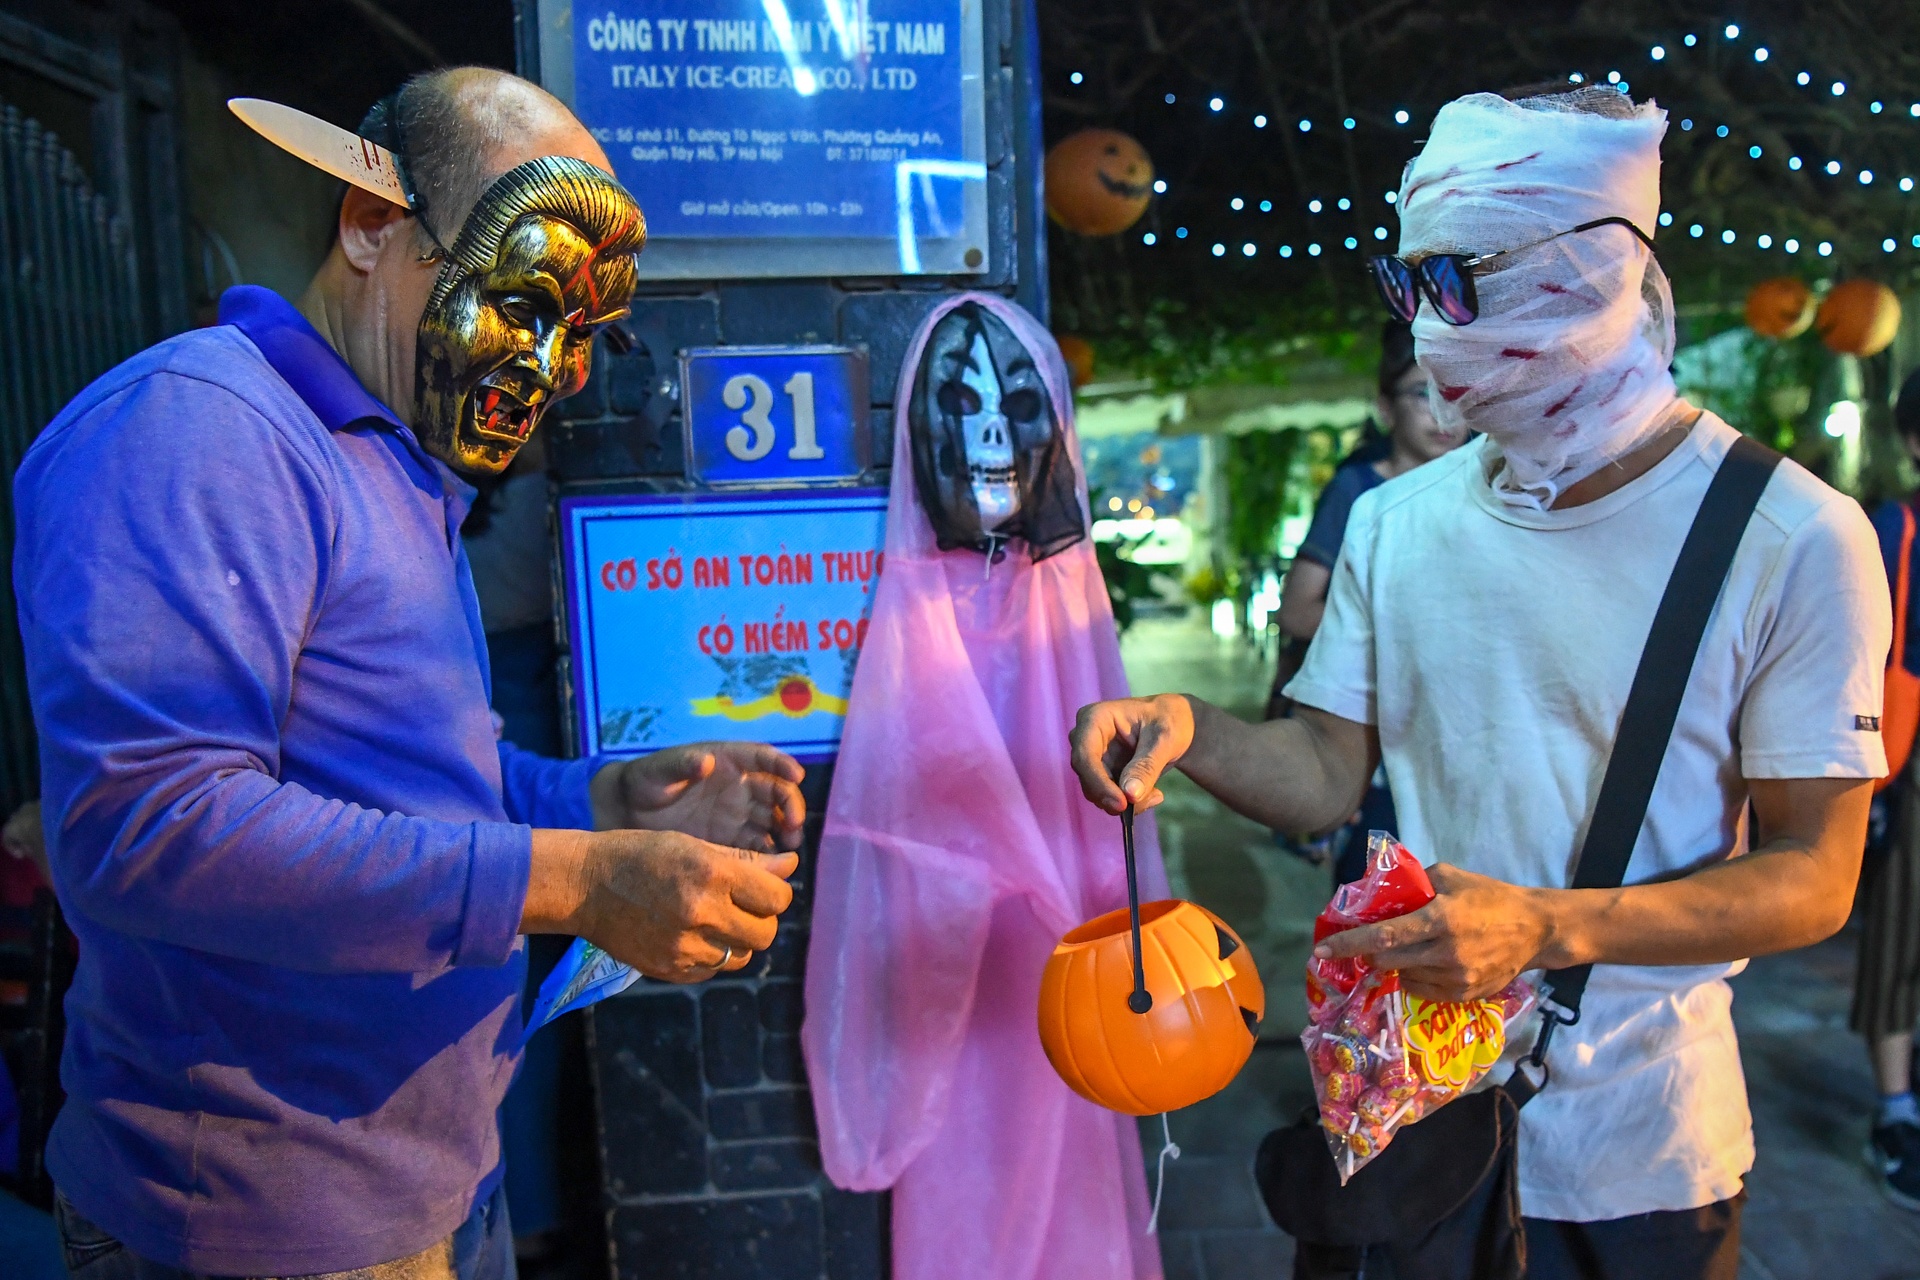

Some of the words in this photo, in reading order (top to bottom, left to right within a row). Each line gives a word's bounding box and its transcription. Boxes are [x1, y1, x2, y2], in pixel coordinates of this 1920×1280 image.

[587, 11, 653, 52] CÔNG
[657, 19, 689, 52] TY
[694, 19, 757, 52] TNHH
[762, 20, 812, 53] KM
[838, 13, 890, 63] ỆT
[895, 22, 946, 55] NAM
[611, 65, 680, 89] ITALY
[686, 65, 814, 90] ICE-CREA
[871, 68, 918, 91] LTD
[722, 371, 826, 462] 31
[600, 557, 637, 592] CƠ
[646, 547, 684, 590] SỞ
[693, 556, 730, 589] AN
[739, 544, 814, 587] TOÀN
[697, 613, 735, 655] CÓ
[743, 603, 809, 654] KIỂM
